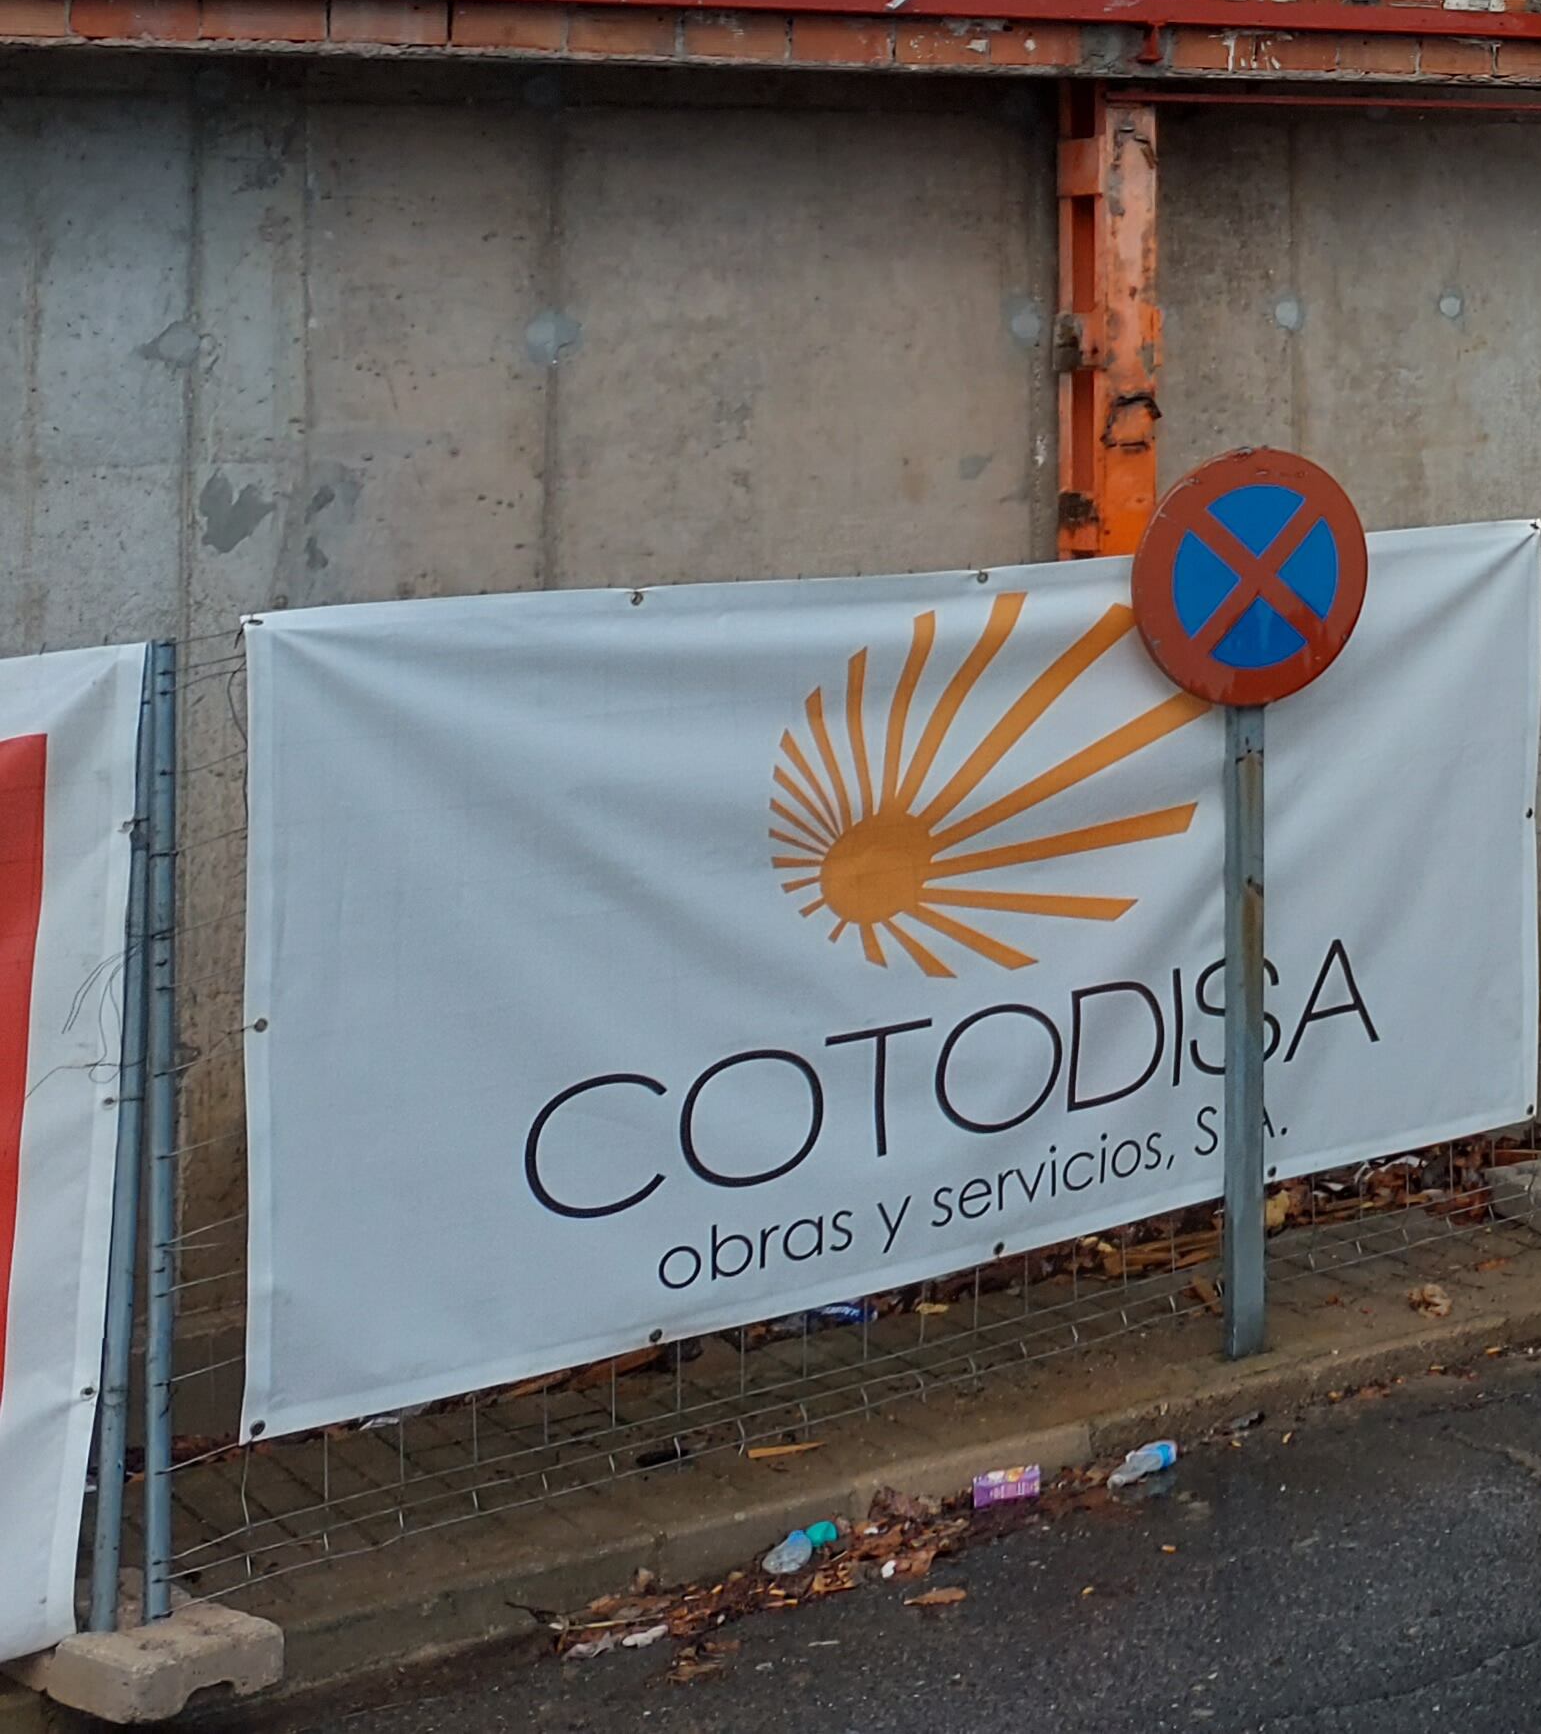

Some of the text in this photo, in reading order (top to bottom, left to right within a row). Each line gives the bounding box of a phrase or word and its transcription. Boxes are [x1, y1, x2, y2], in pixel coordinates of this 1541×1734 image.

[523, 938, 1381, 1219] COTODISA
[657, 1104, 1289, 1291] obras y servicios, S.
